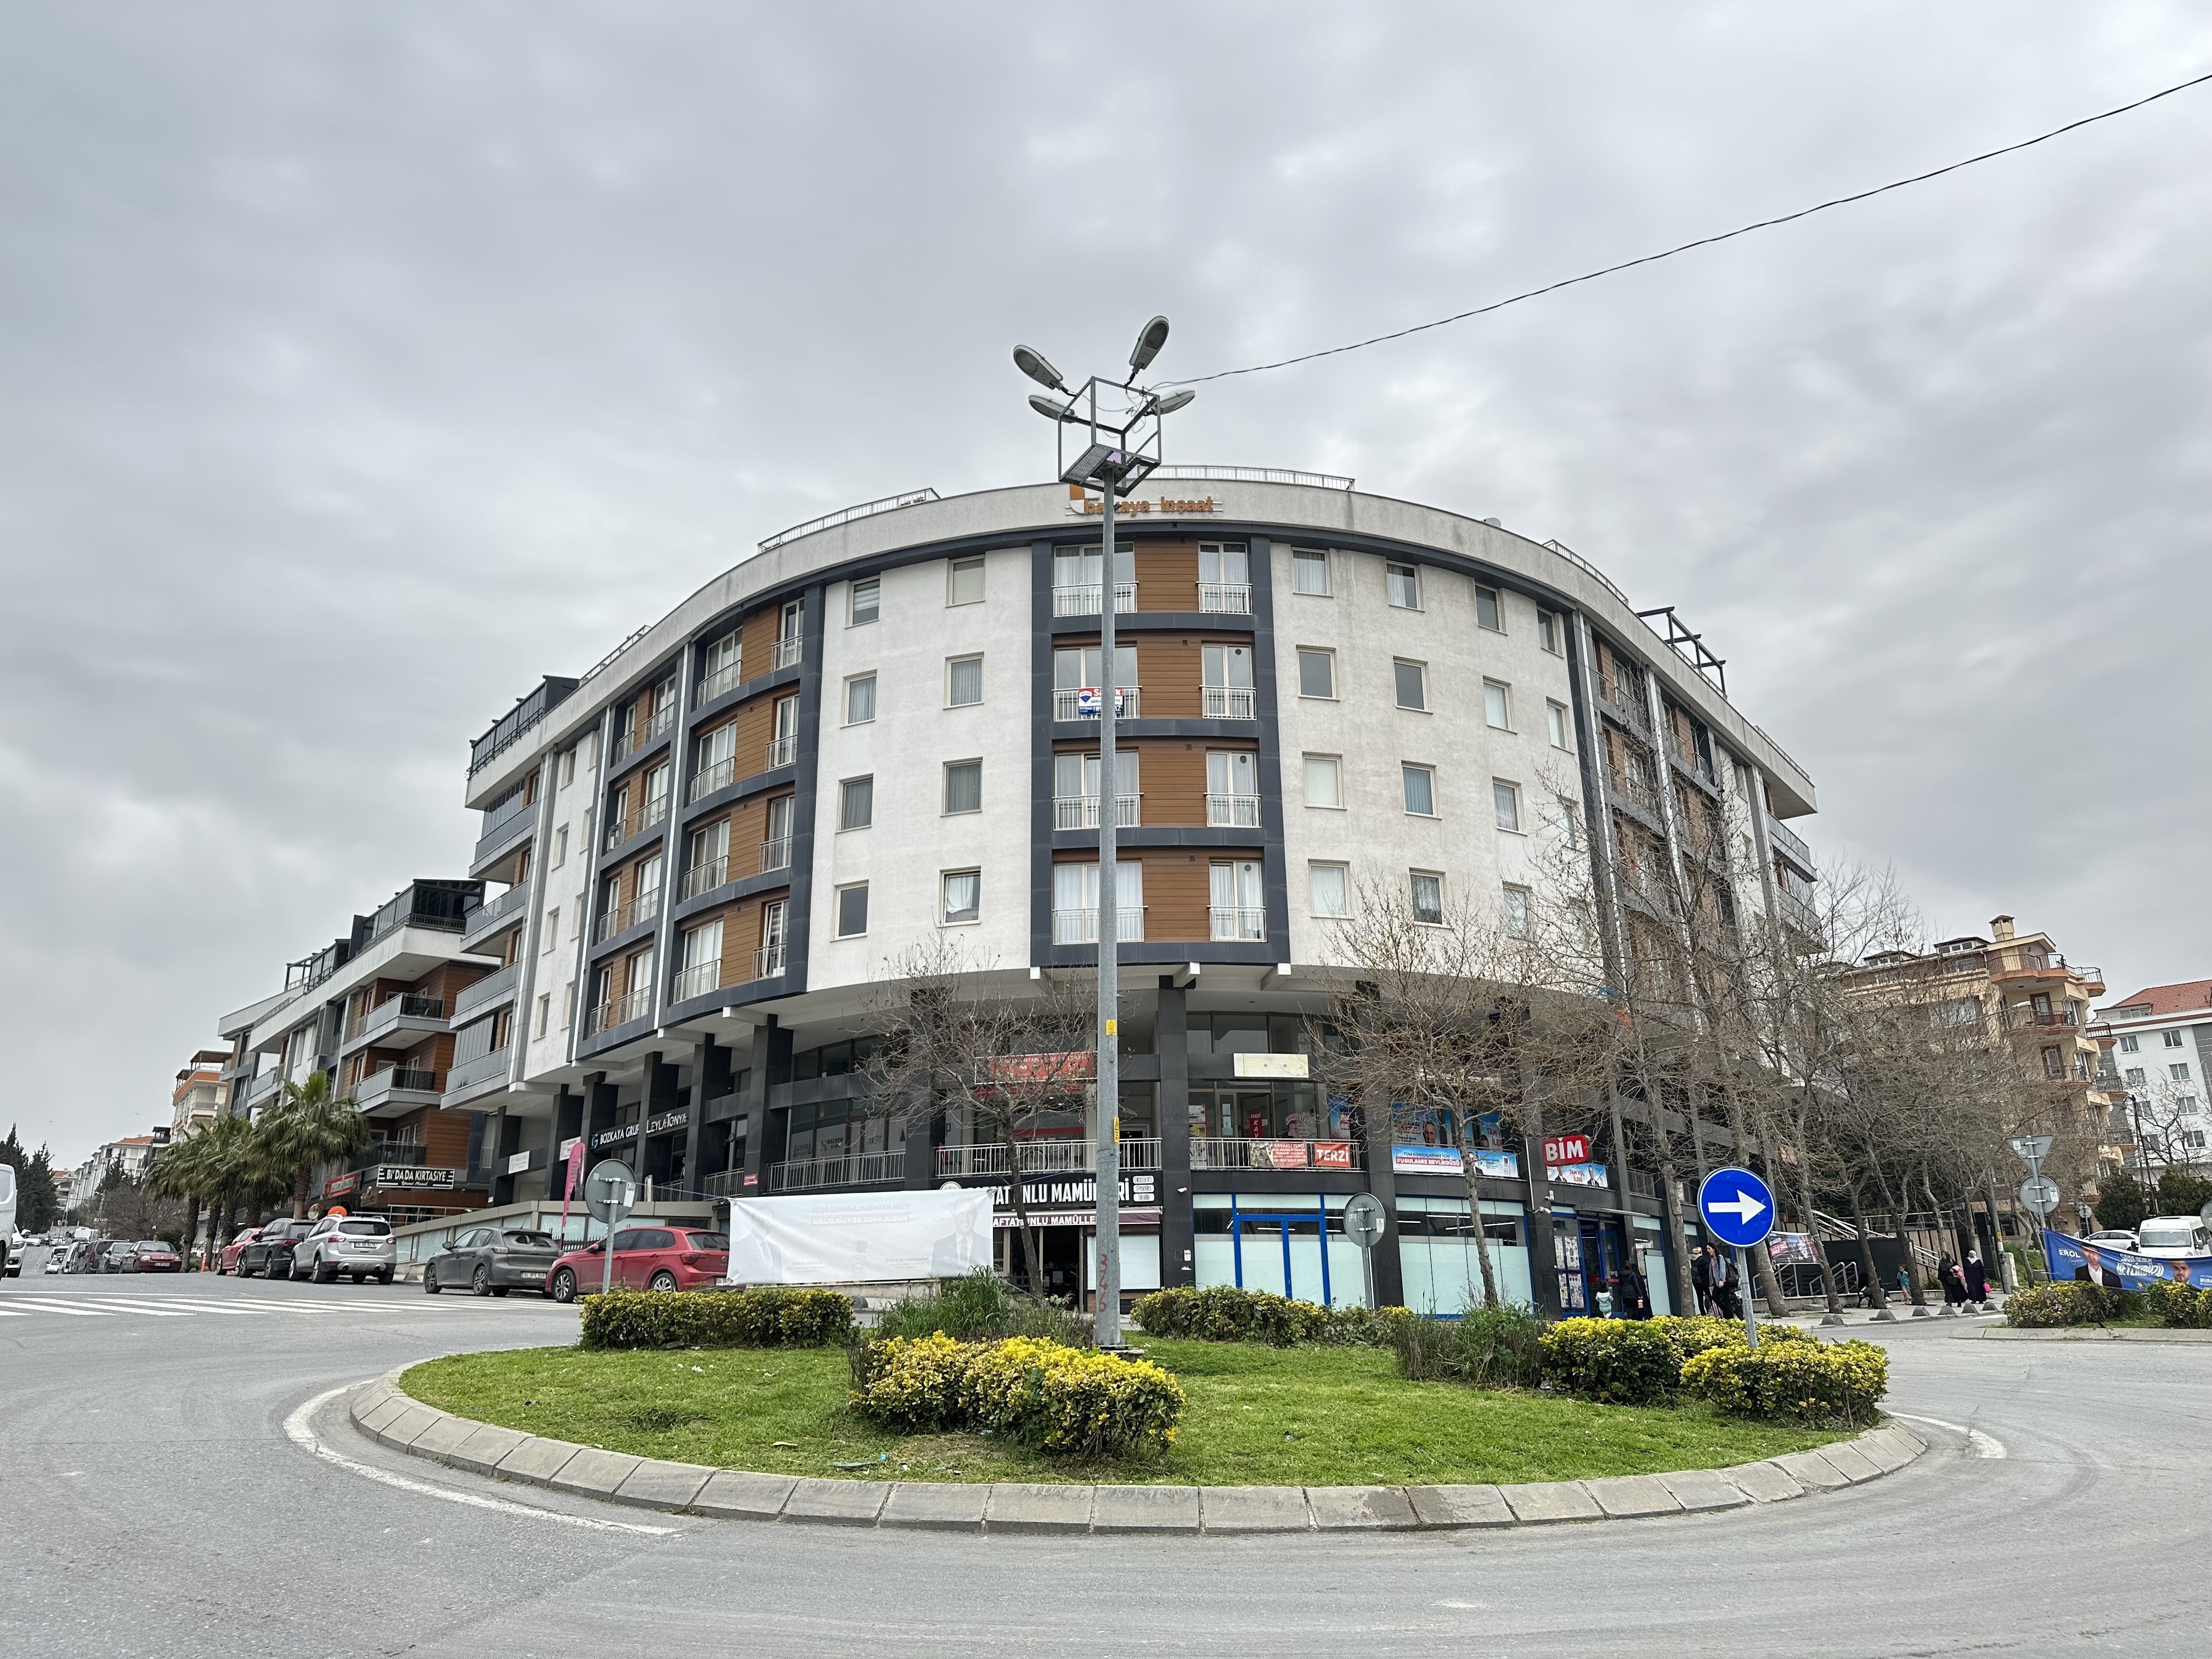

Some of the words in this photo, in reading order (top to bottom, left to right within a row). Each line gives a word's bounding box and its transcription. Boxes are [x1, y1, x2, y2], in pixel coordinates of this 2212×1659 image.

[600, 1128, 624, 1145] BOZKAYA
[1316, 1146, 1349, 1163] TERZİ
[1545, 1137, 1584, 1161] BİM
[1013, 1184, 1047, 1204] NLU
[993, 1217, 1019, 1227] AFTAT
[1051, 1214, 1097, 1225] MAMÜLLE
[2058, 1249, 2081, 1258] EROL
